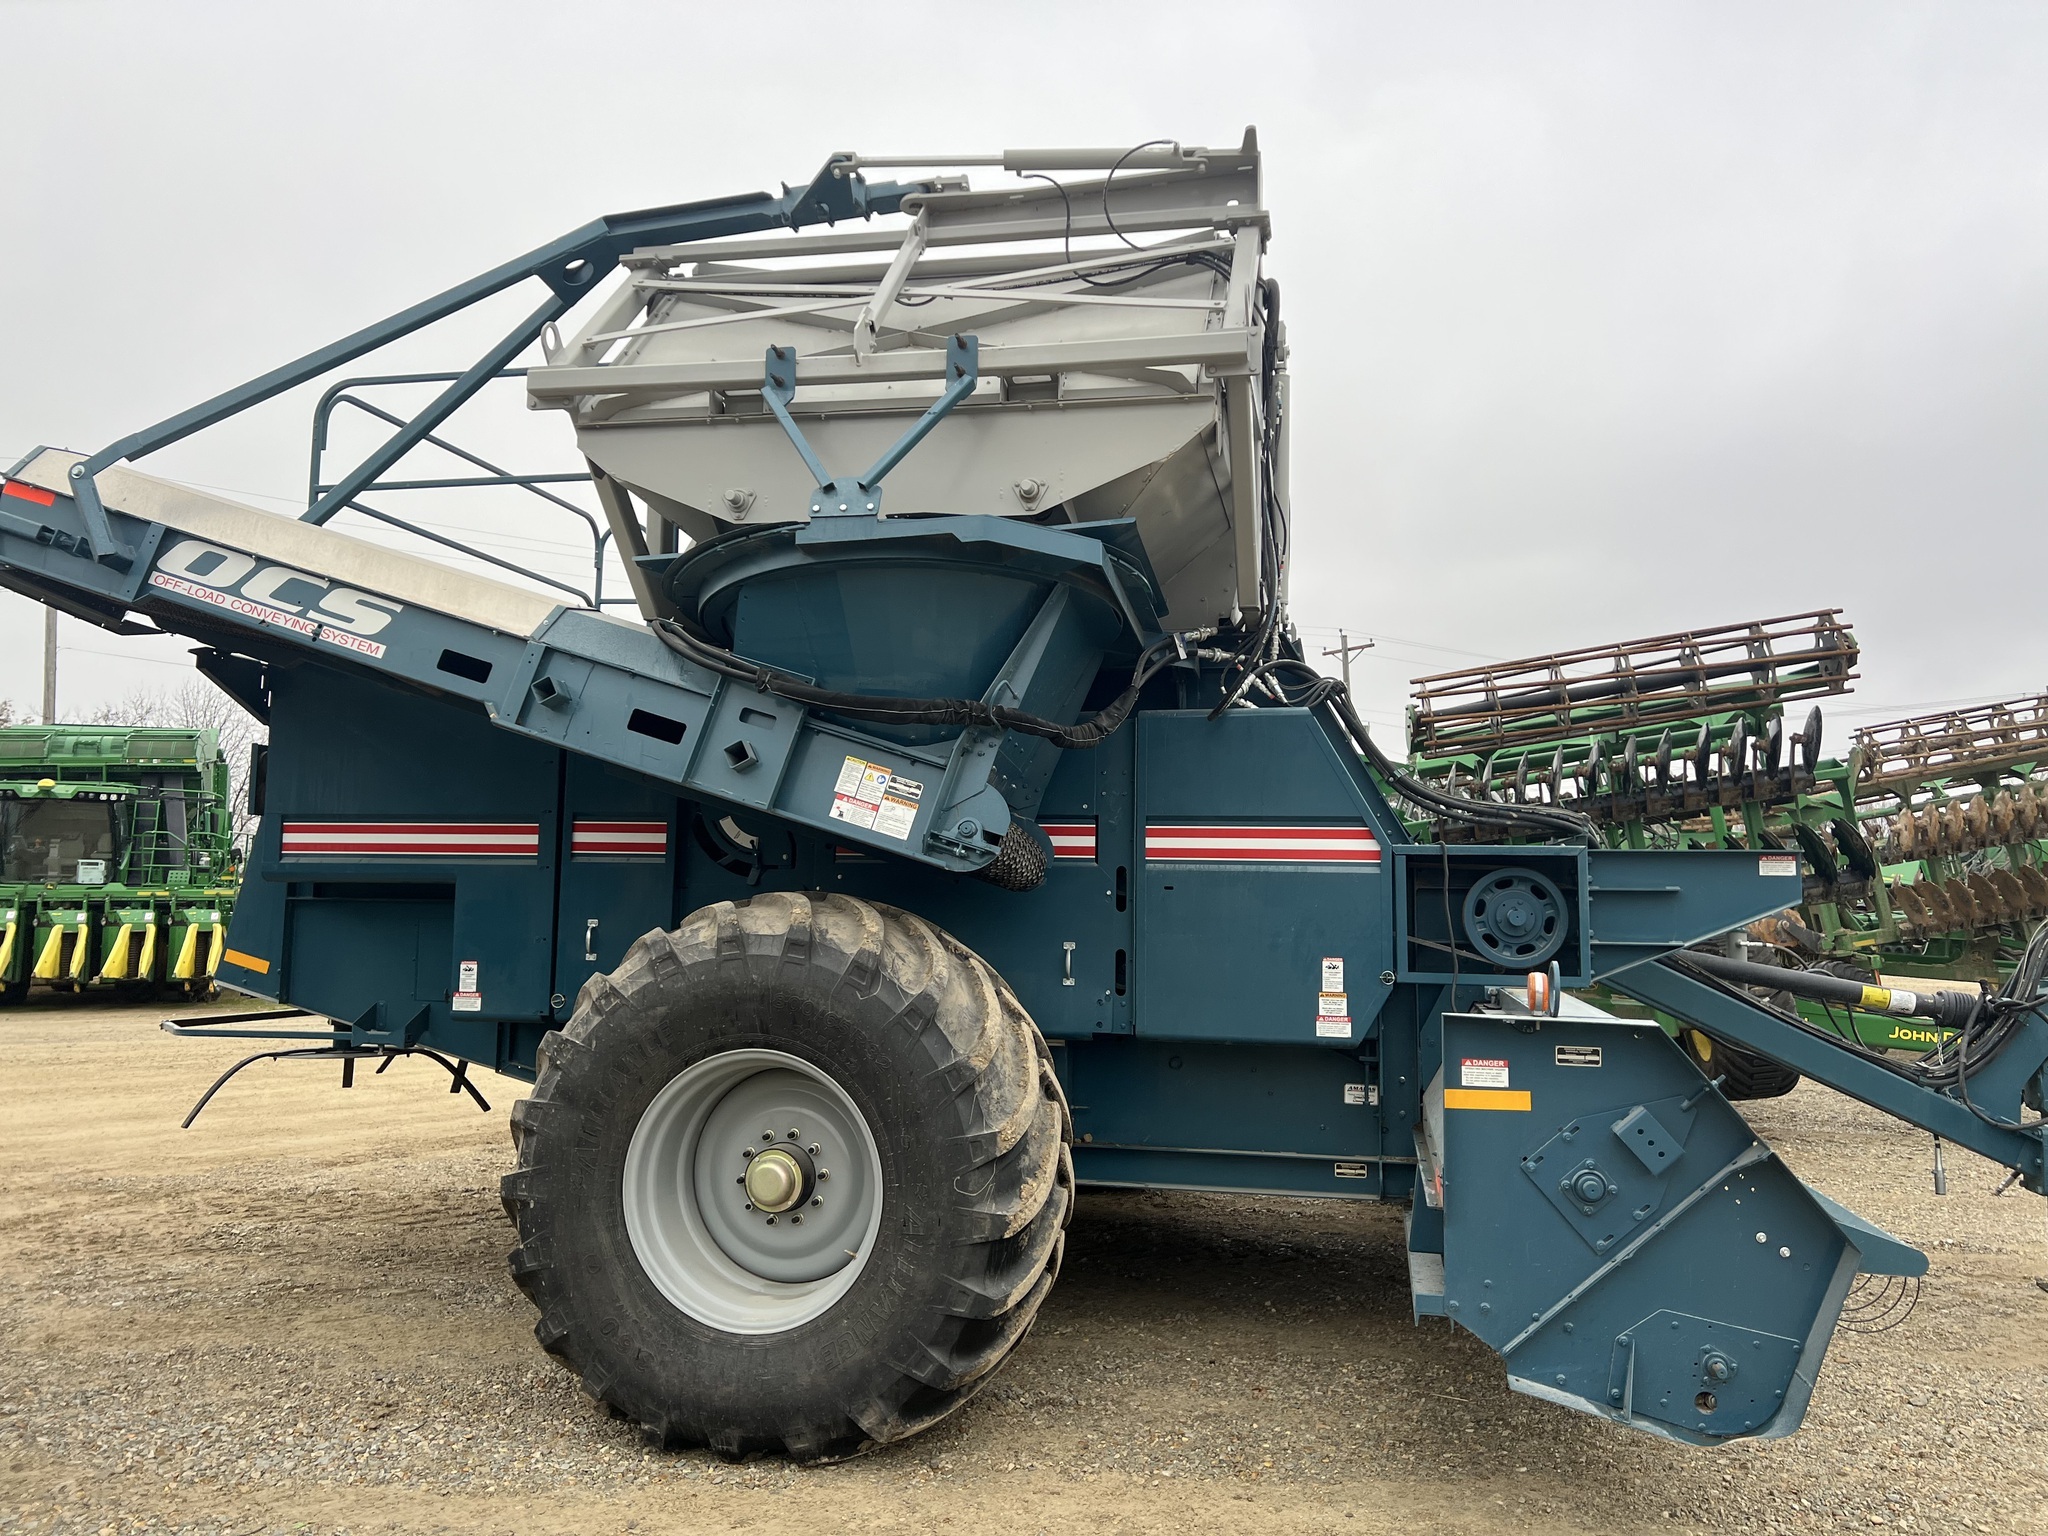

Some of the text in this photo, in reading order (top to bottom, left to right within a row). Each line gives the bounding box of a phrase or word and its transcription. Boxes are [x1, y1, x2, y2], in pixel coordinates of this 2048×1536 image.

[156, 540, 404, 635] OCS
[154, 574, 380, 656] OFF-LOAD CONVEYING SYSTEM
[848, 798, 873, 810] DANGER
[890, 796, 917, 809] WARNING
[1888, 1026, 1938, 1044] JOHN
[1472, 1059, 1505, 1067] DANGER
[1347, 1085, 1376, 1093] AMAAS
